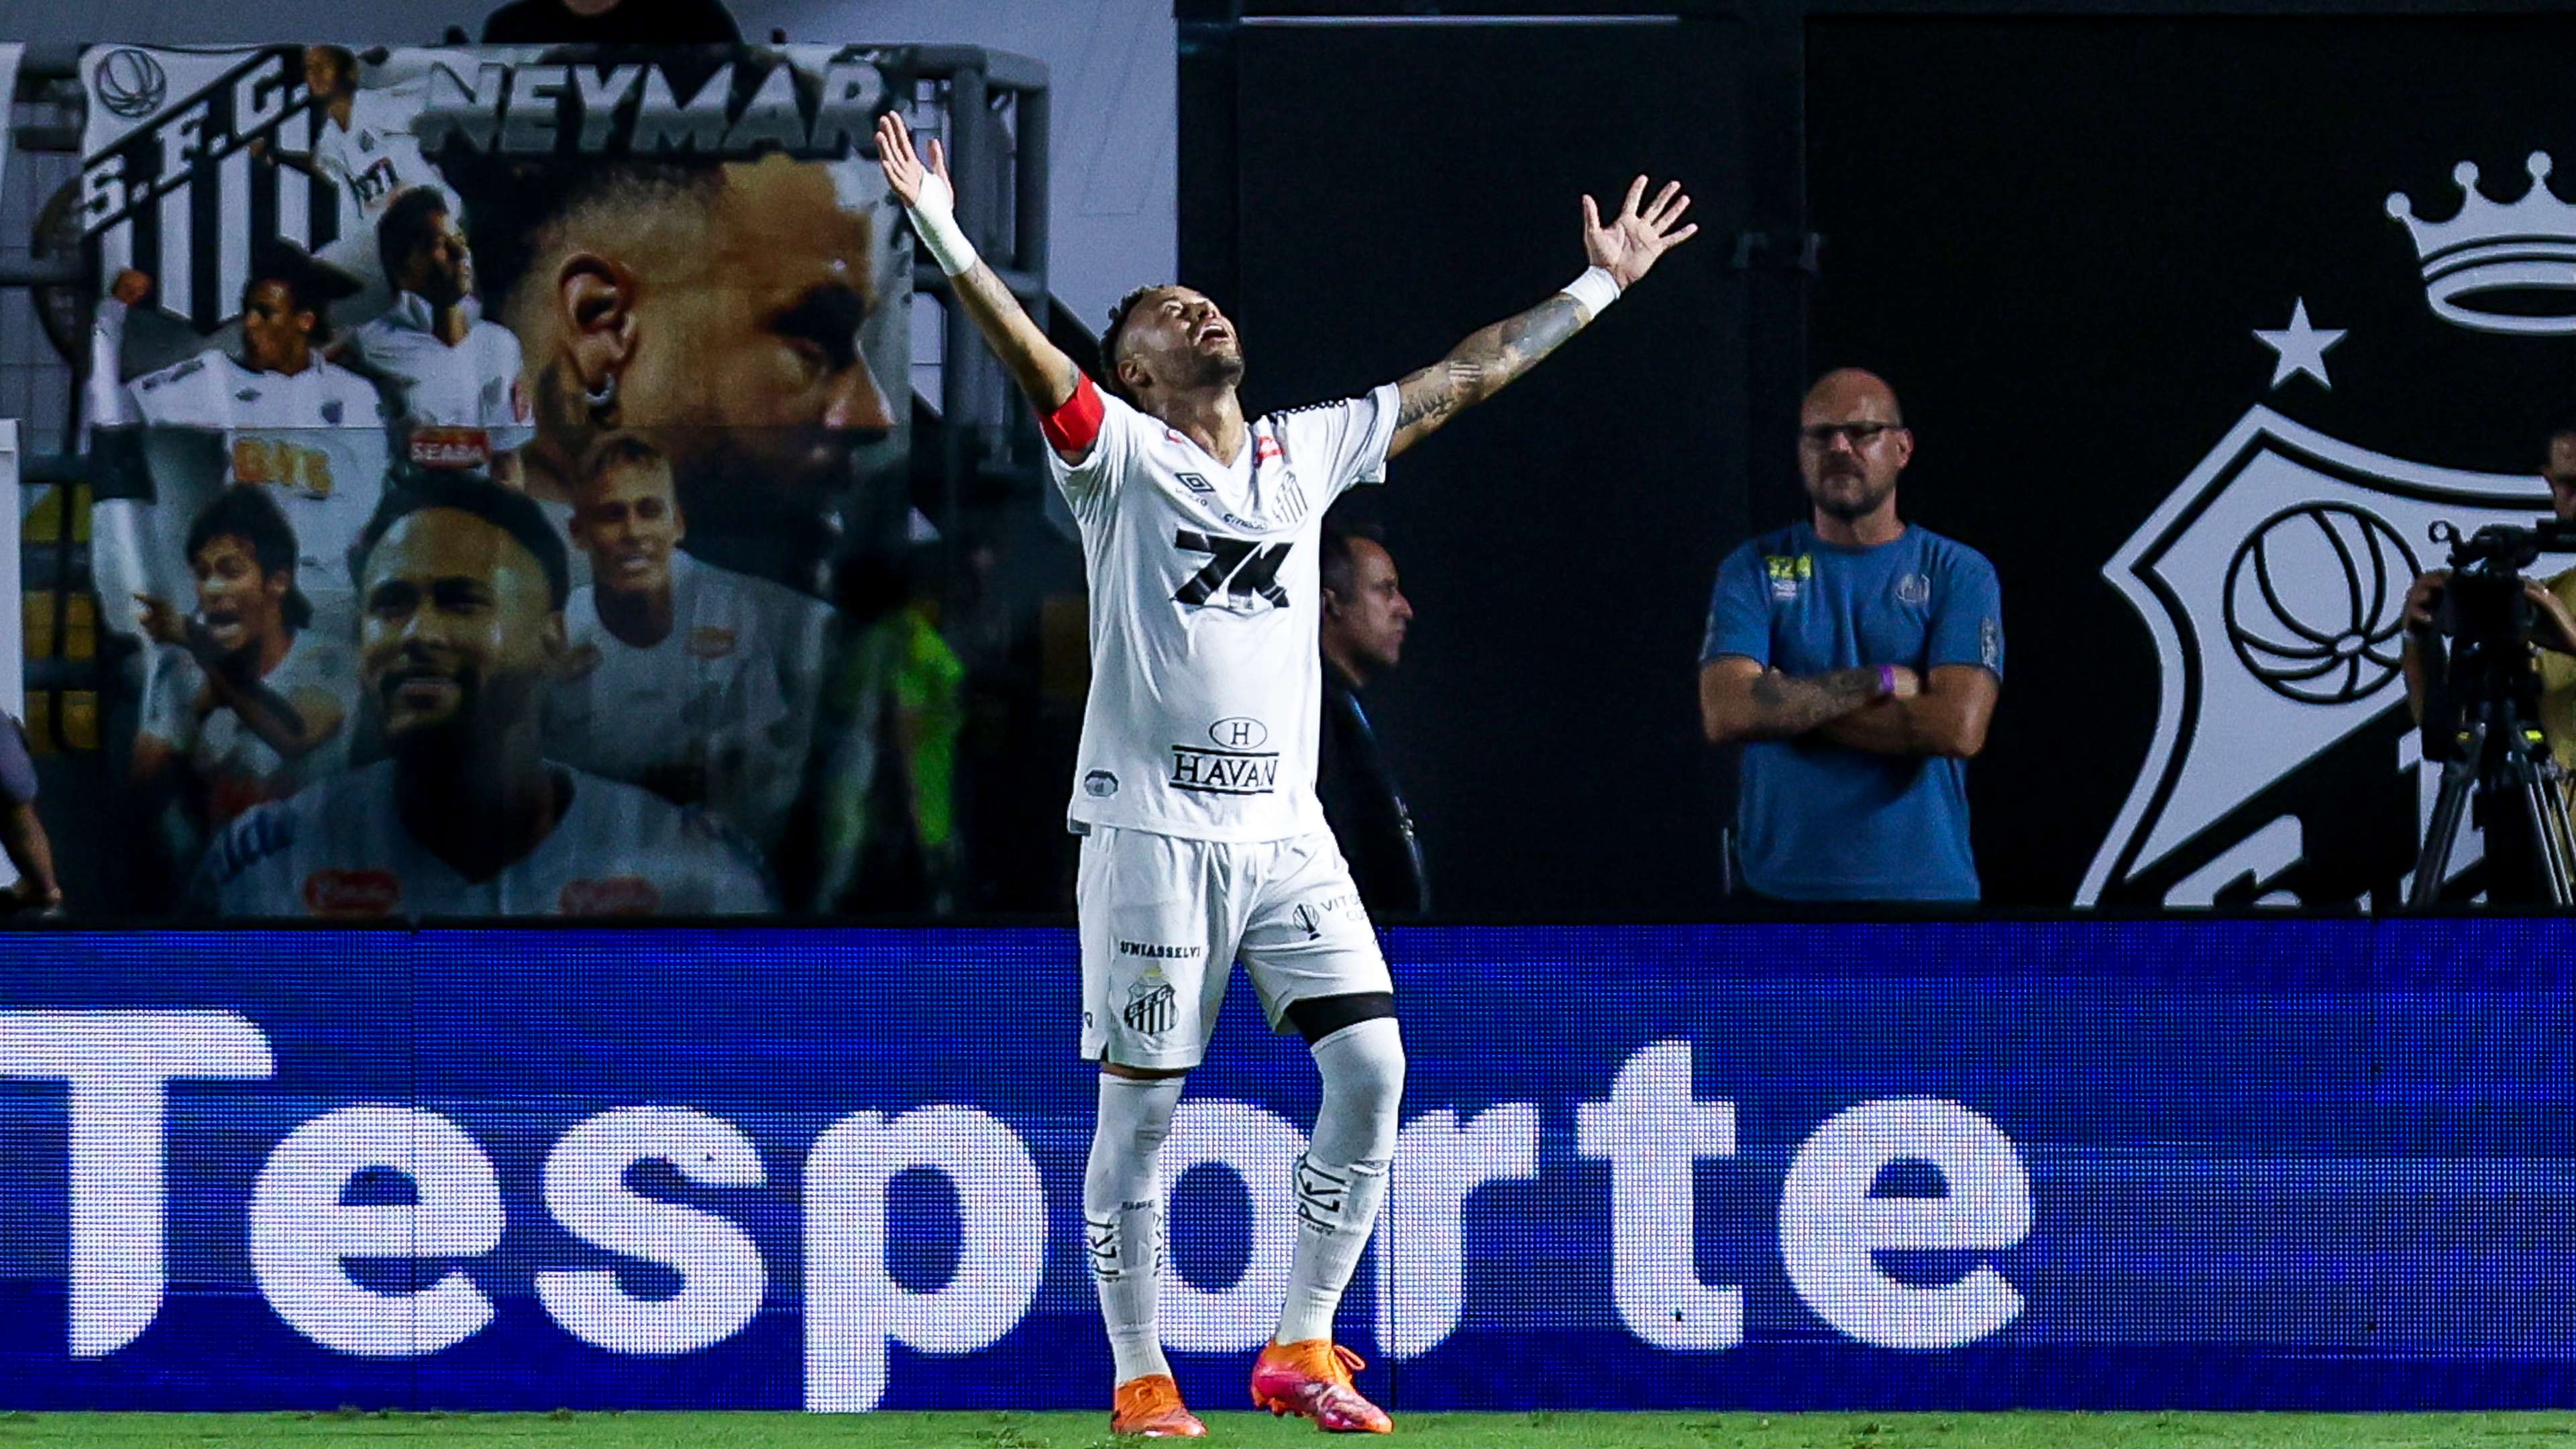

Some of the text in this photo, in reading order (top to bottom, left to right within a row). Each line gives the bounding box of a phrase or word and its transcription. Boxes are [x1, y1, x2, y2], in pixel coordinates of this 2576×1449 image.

[417, 62, 885, 156] NEYMAR
[1231, 722, 1250, 745] H
[1171, 753, 1277, 787] HAVAN
[1120, 941, 1200, 958] UNIASSELVI
[0, 1010, 2033, 1413] Tesporte
